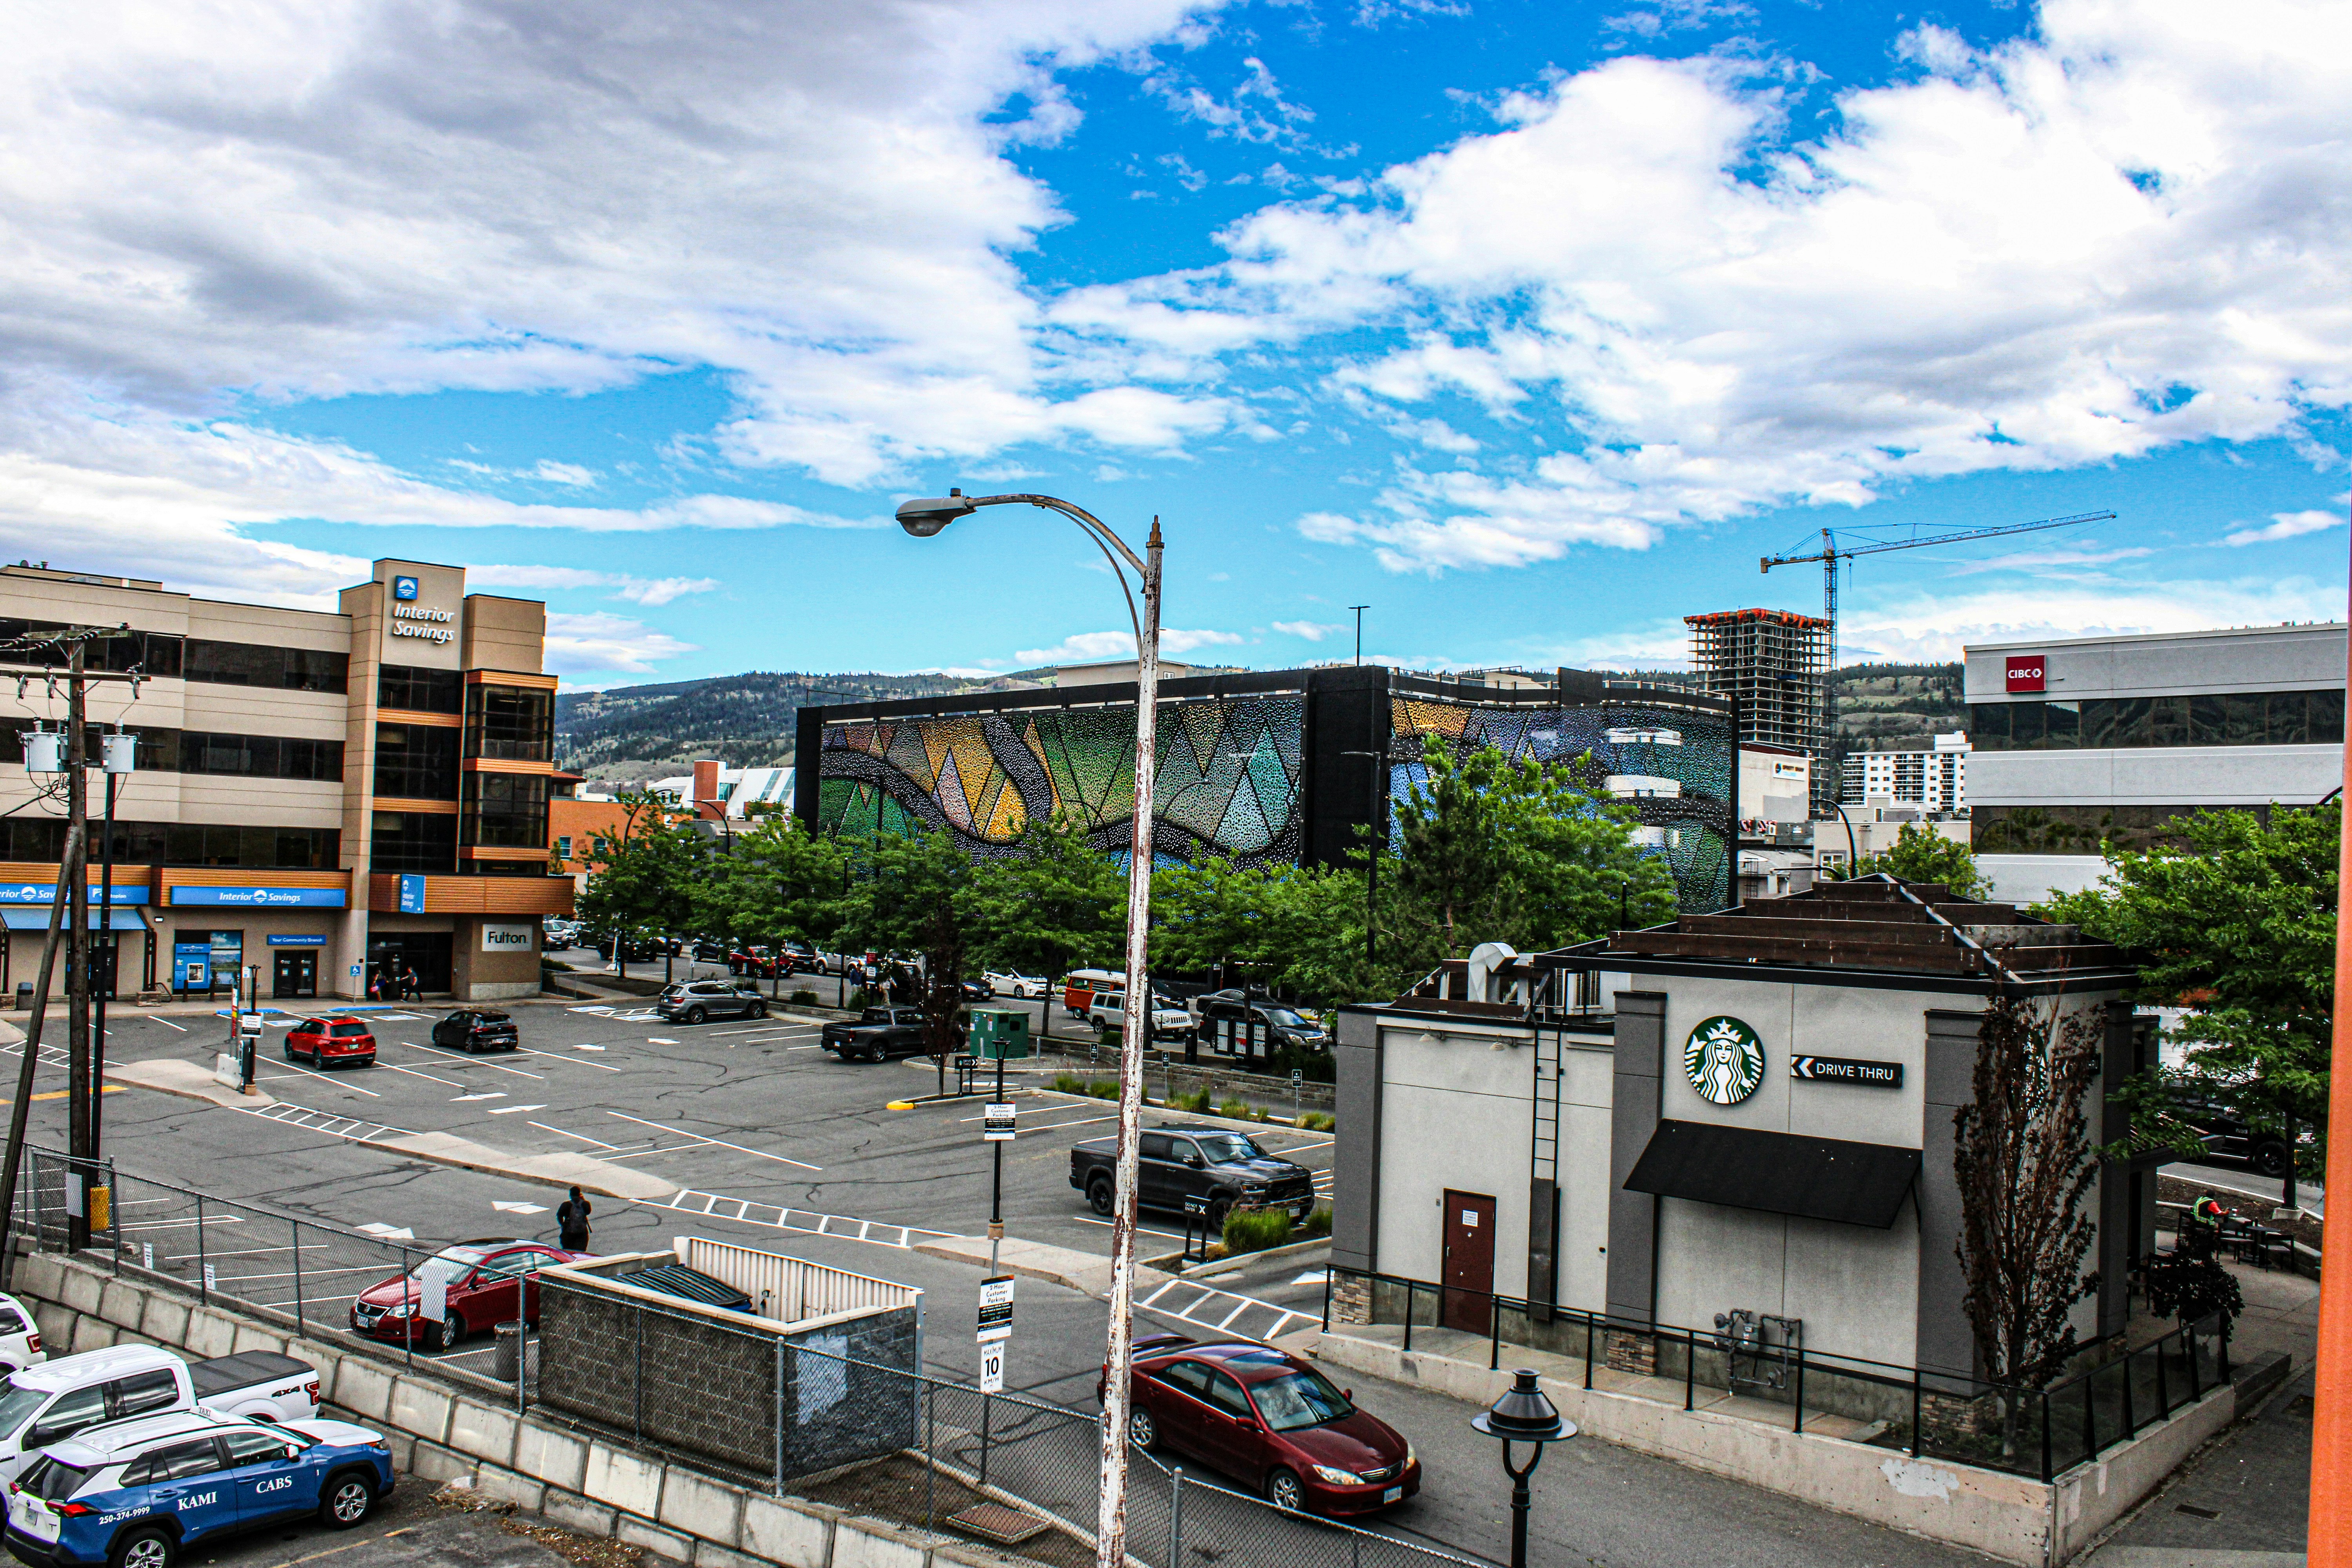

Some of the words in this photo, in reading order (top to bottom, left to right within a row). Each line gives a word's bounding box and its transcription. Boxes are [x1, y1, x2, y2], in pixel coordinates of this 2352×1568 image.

[393, 603, 454, 622] Interior
[393, 621, 454, 644] Savings
[2008, 669, 2031, 679] CIBC
[0, 889, 20, 898] rior
[268, 893, 301, 903] Savings
[488, 931, 526, 944] Fulton
[1816, 1063, 1855, 1077] DRIVE
[1858, 1067, 1893, 1080] THRU
[984, 1346, 1002, 1356] MAXIMUM
[985, 1356, 999, 1377] 10
[984, 1376, 999, 1385] KM/H
[199, 1406, 211, 1417] TAXI
[178, 1491, 217, 1511] KAMI
[256, 1475, 292, 1494] CABS
[99, 1506, 150, 1525] 250-374-9999
